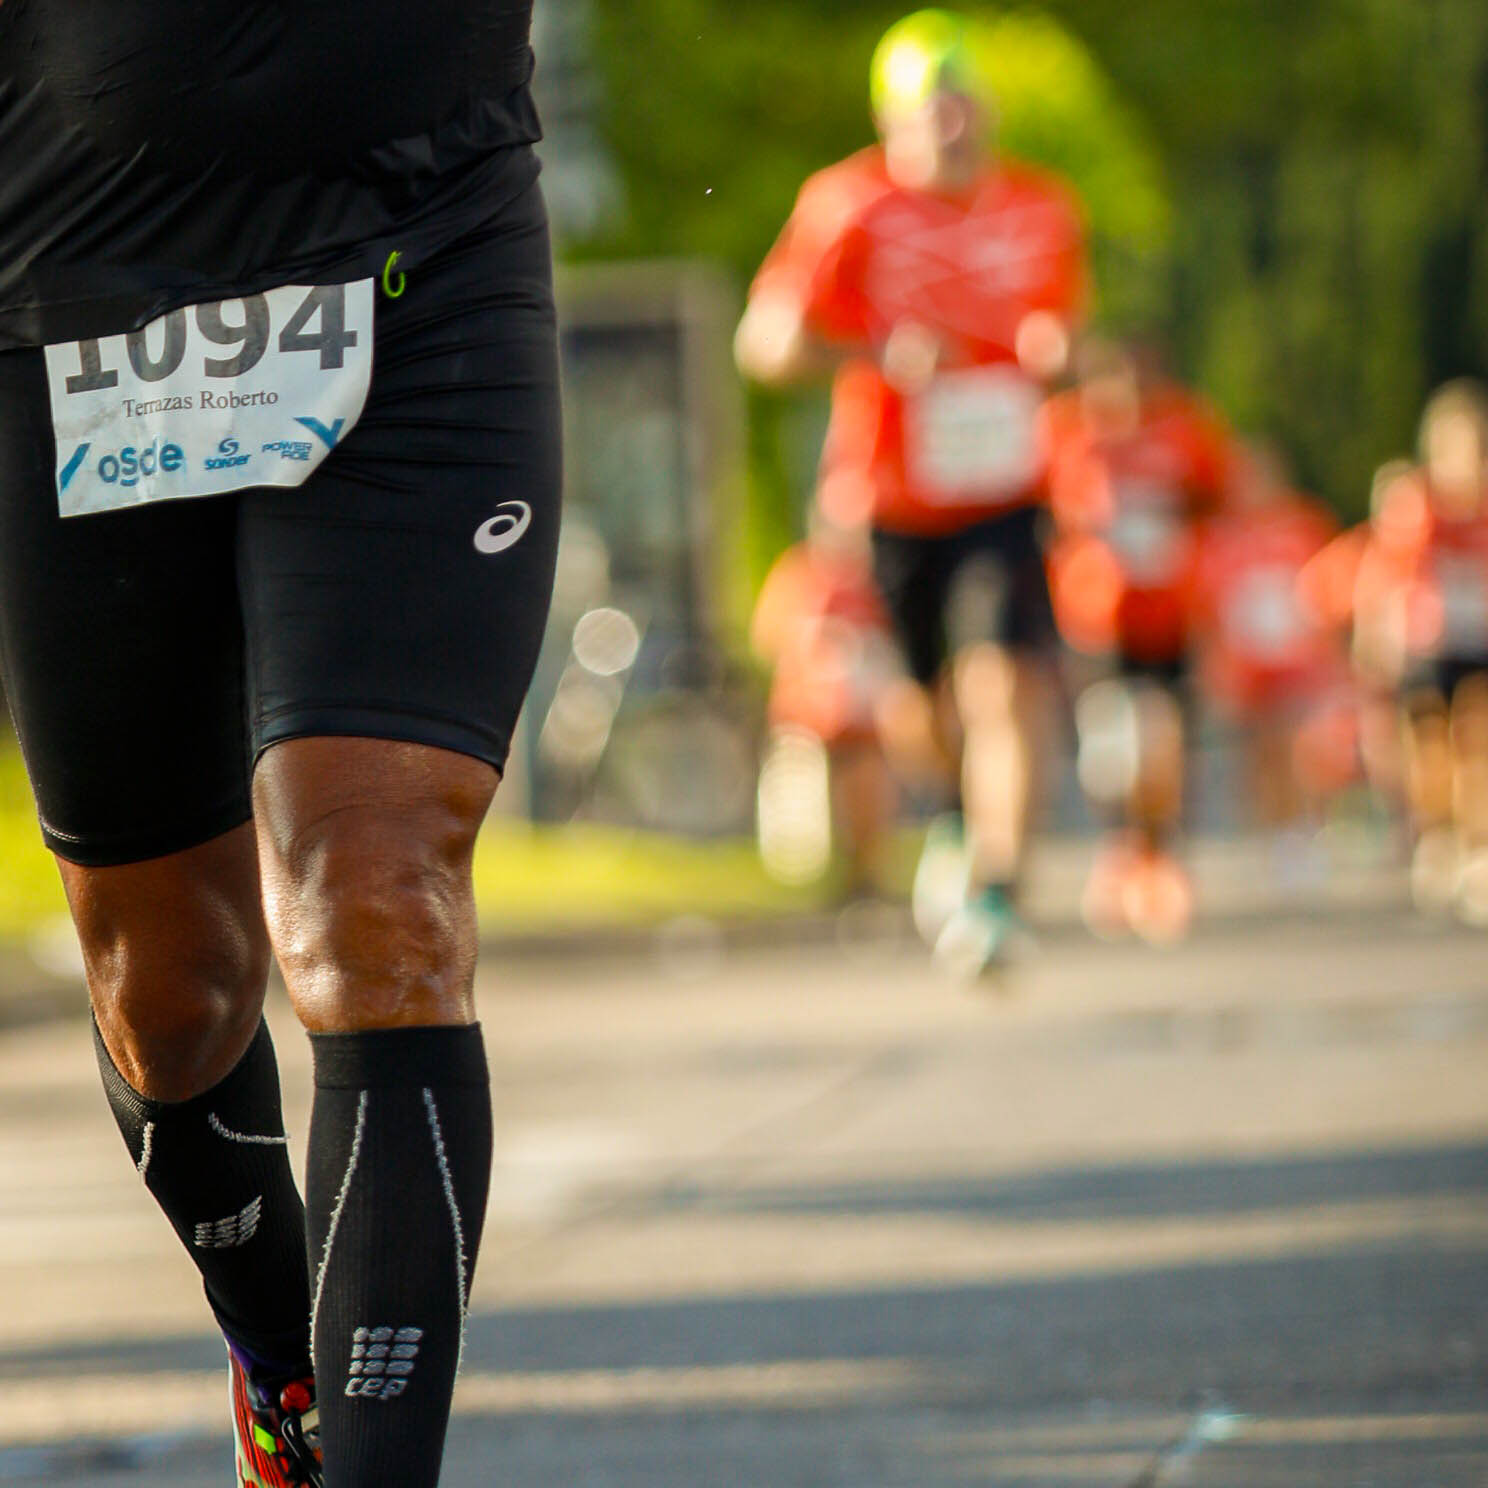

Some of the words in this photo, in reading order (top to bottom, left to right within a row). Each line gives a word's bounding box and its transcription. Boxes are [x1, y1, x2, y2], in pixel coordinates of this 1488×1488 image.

[65, 283, 358, 394] 1094
[122, 394, 193, 418] Terrazas
[199, 390, 279, 410] Roberto
[98, 438, 185, 486] osde
[344, 1377, 408, 1401] cep
